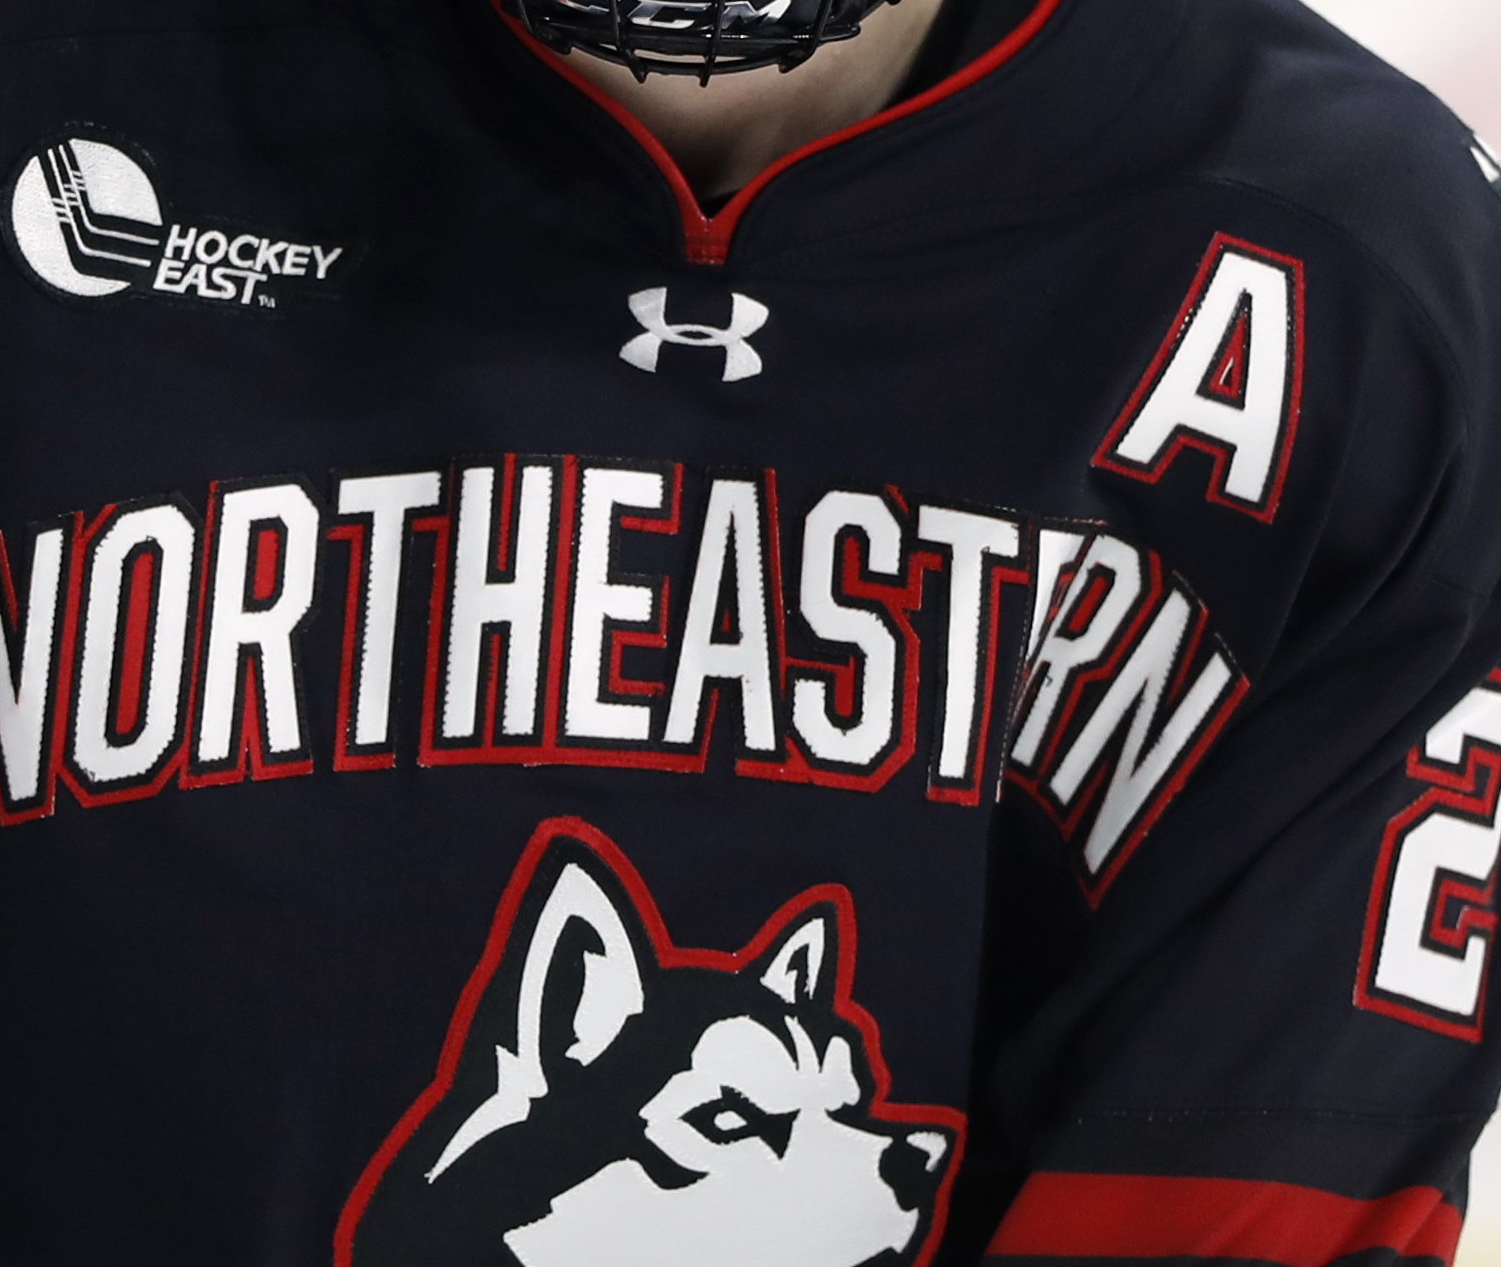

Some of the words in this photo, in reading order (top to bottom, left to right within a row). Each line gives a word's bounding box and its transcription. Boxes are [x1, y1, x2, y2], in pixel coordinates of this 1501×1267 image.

[164, 224, 342, 279] HOCKEY
[153, 257, 267, 304] EAST
[1095, 231, 1304, 524] A
